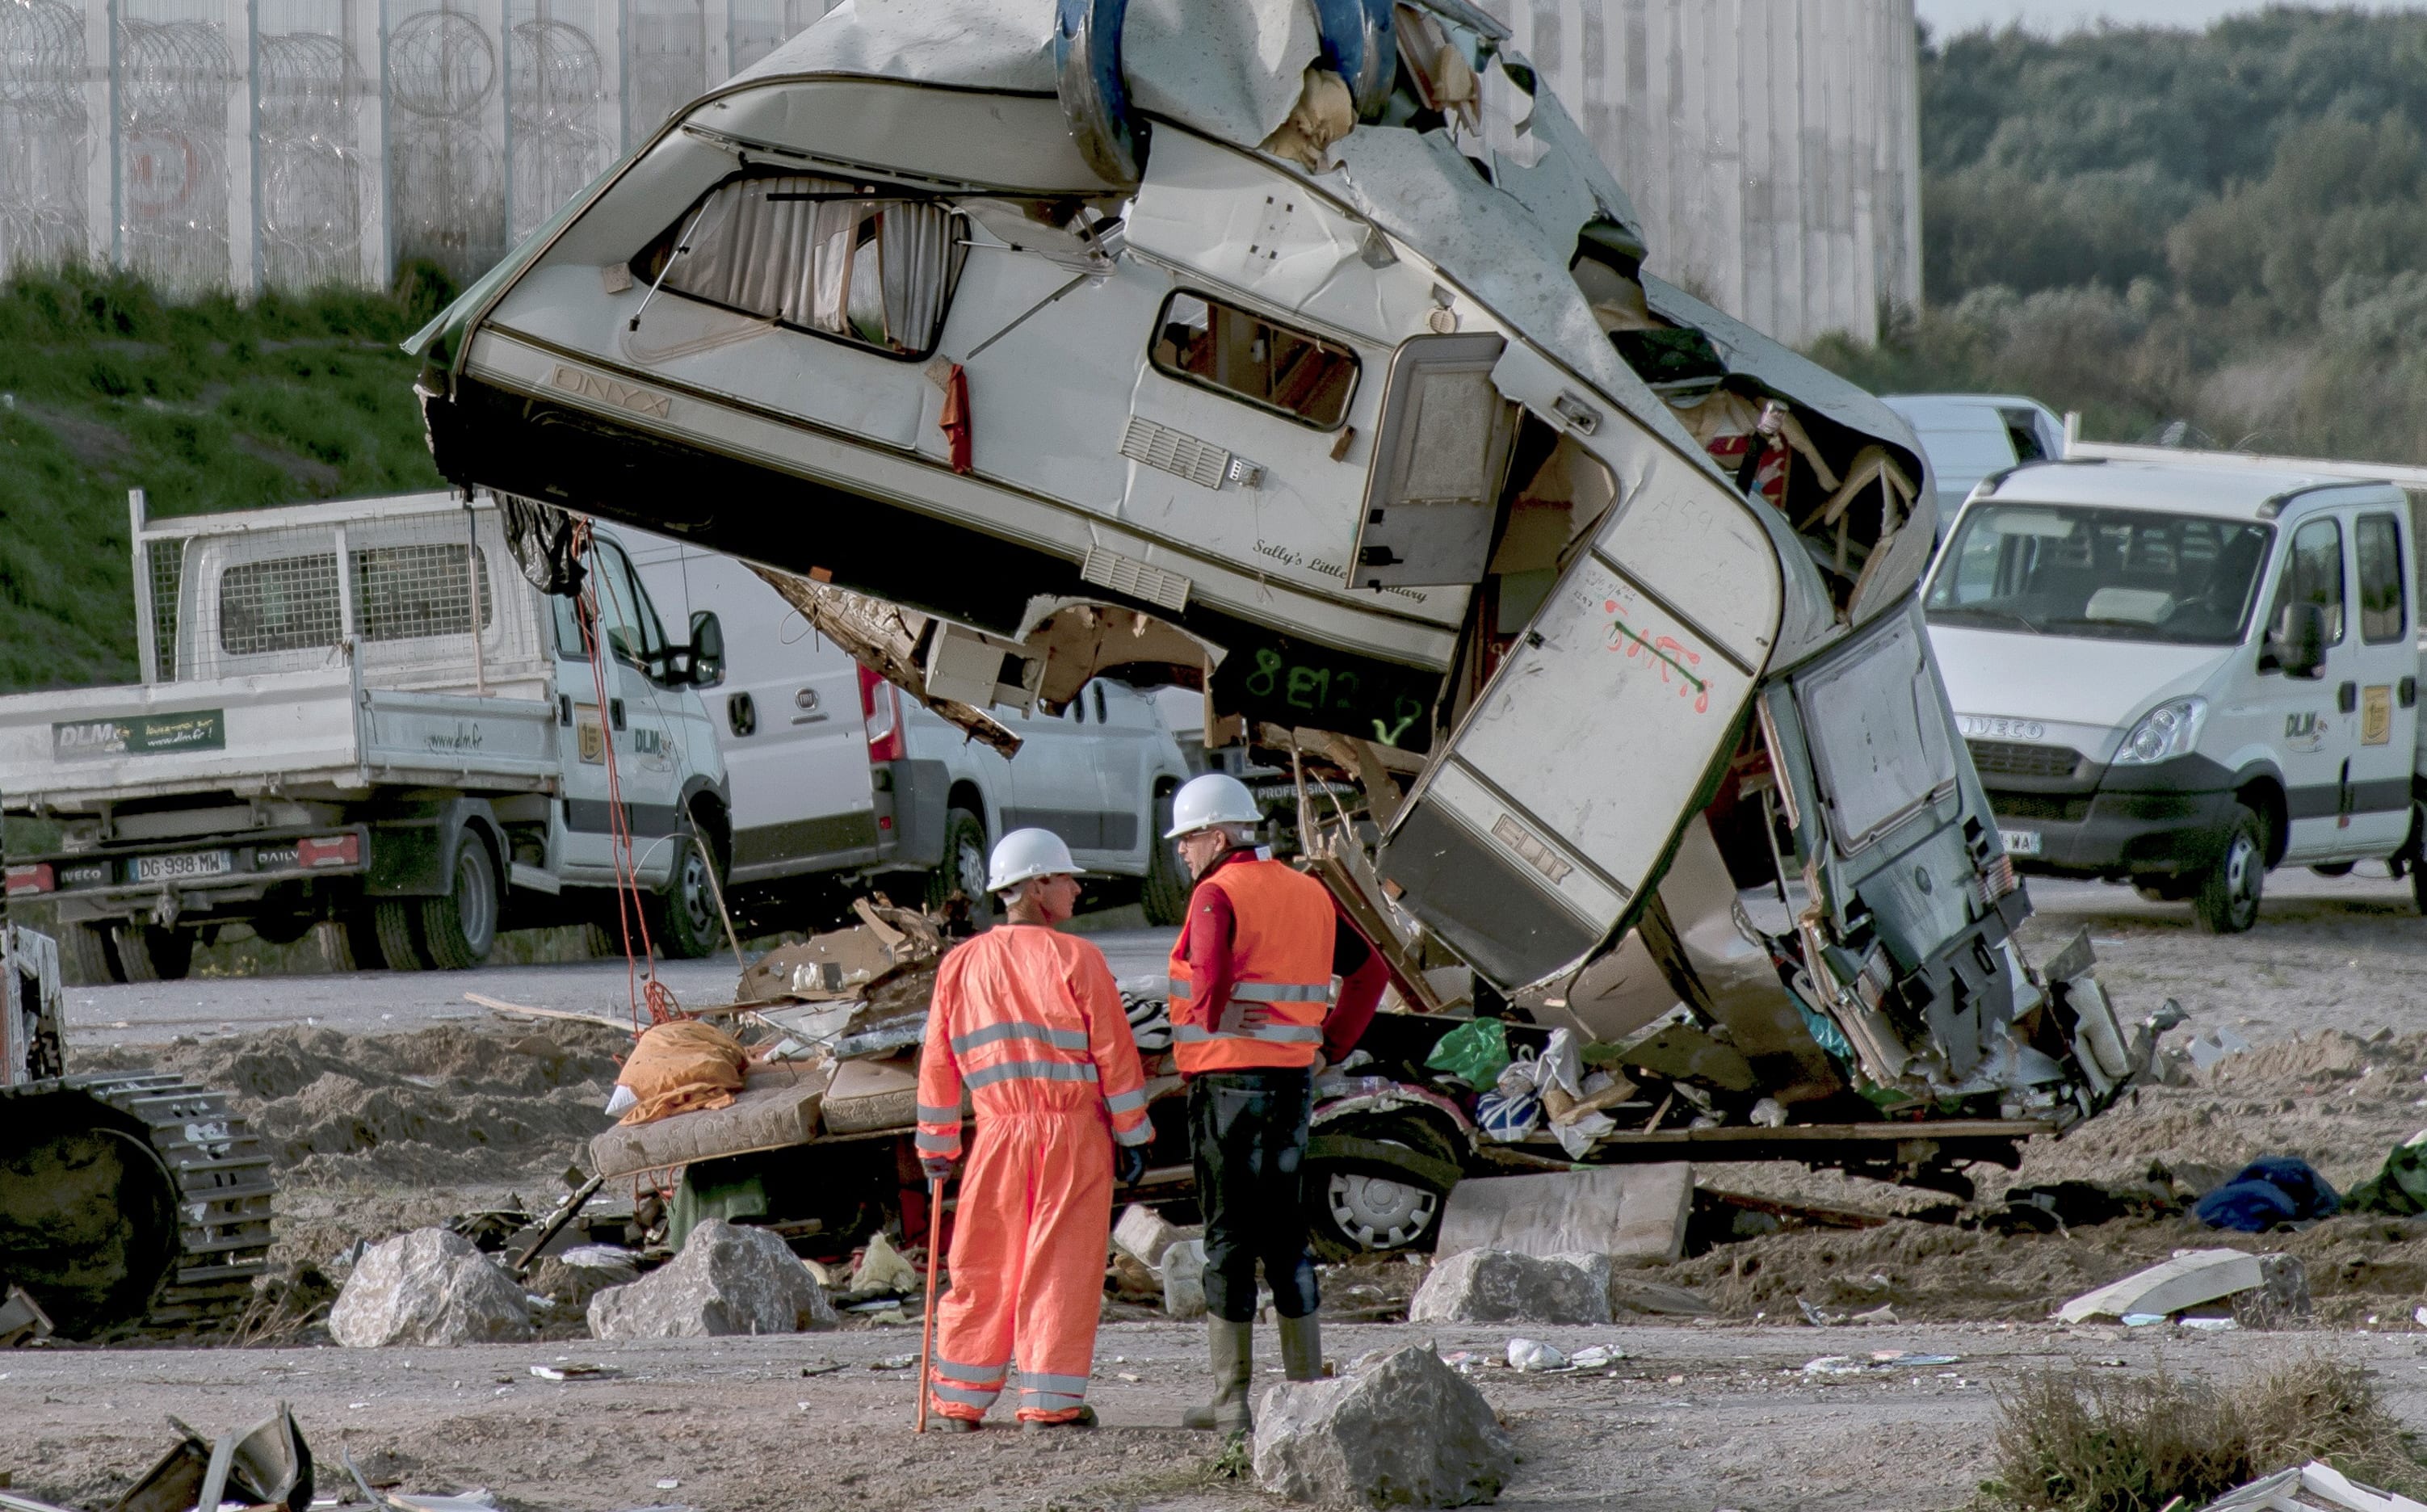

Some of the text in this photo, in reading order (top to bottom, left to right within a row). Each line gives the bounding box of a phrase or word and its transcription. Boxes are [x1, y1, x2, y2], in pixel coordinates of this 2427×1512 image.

[555, 368, 669, 418] ONYX
[1253, 539, 1302, 565] Sally's
[1307, 558, 1347, 579] Little
[61, 723, 113, 746] DLM
[1963, 717, 2044, 739] IVECO
[634, 728, 660, 754] DLM
[258, 850, 299, 863] DAILY
[61, 869, 102, 883] IVECO
